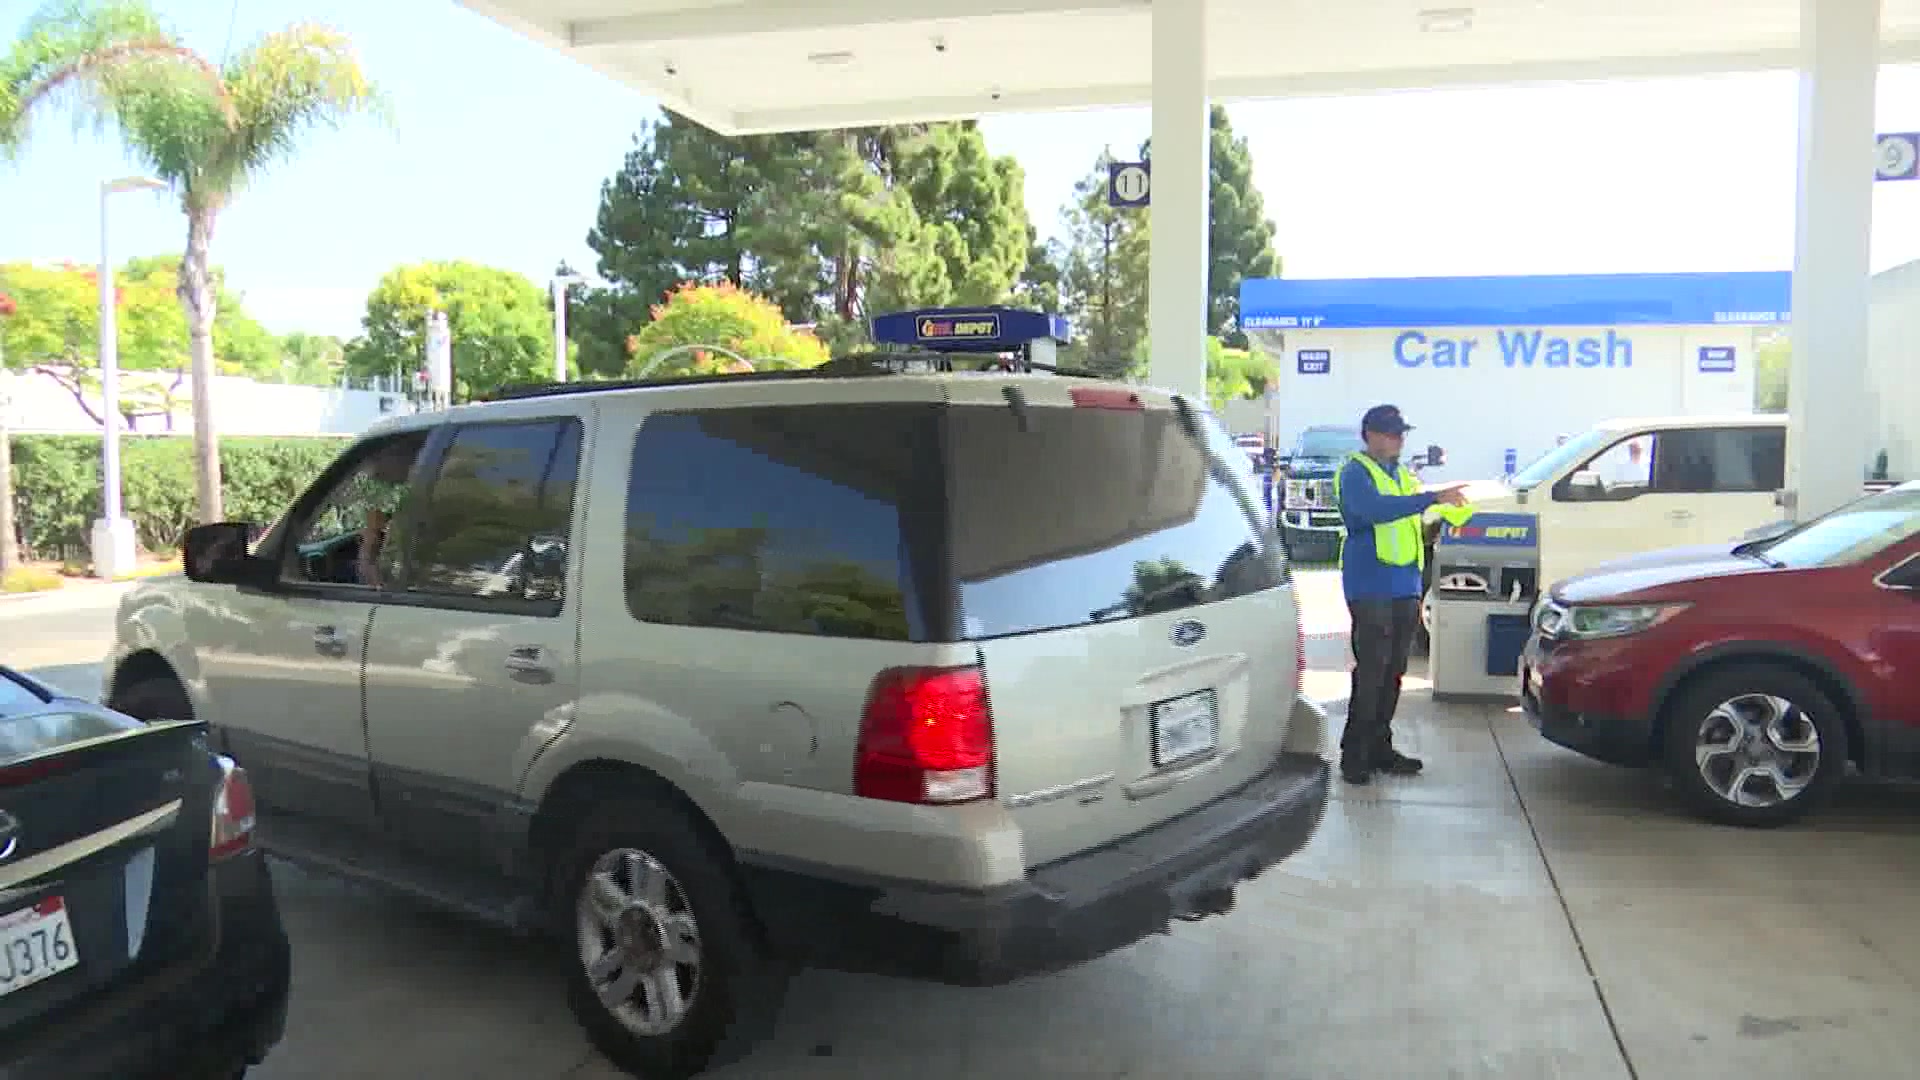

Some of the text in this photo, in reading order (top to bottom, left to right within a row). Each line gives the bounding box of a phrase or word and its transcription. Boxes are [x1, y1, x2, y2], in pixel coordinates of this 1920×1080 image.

[1886, 144, 1903, 169] 9
[1121, 175, 1143, 193] 11
[1393, 329, 1633, 368] Car Wash
